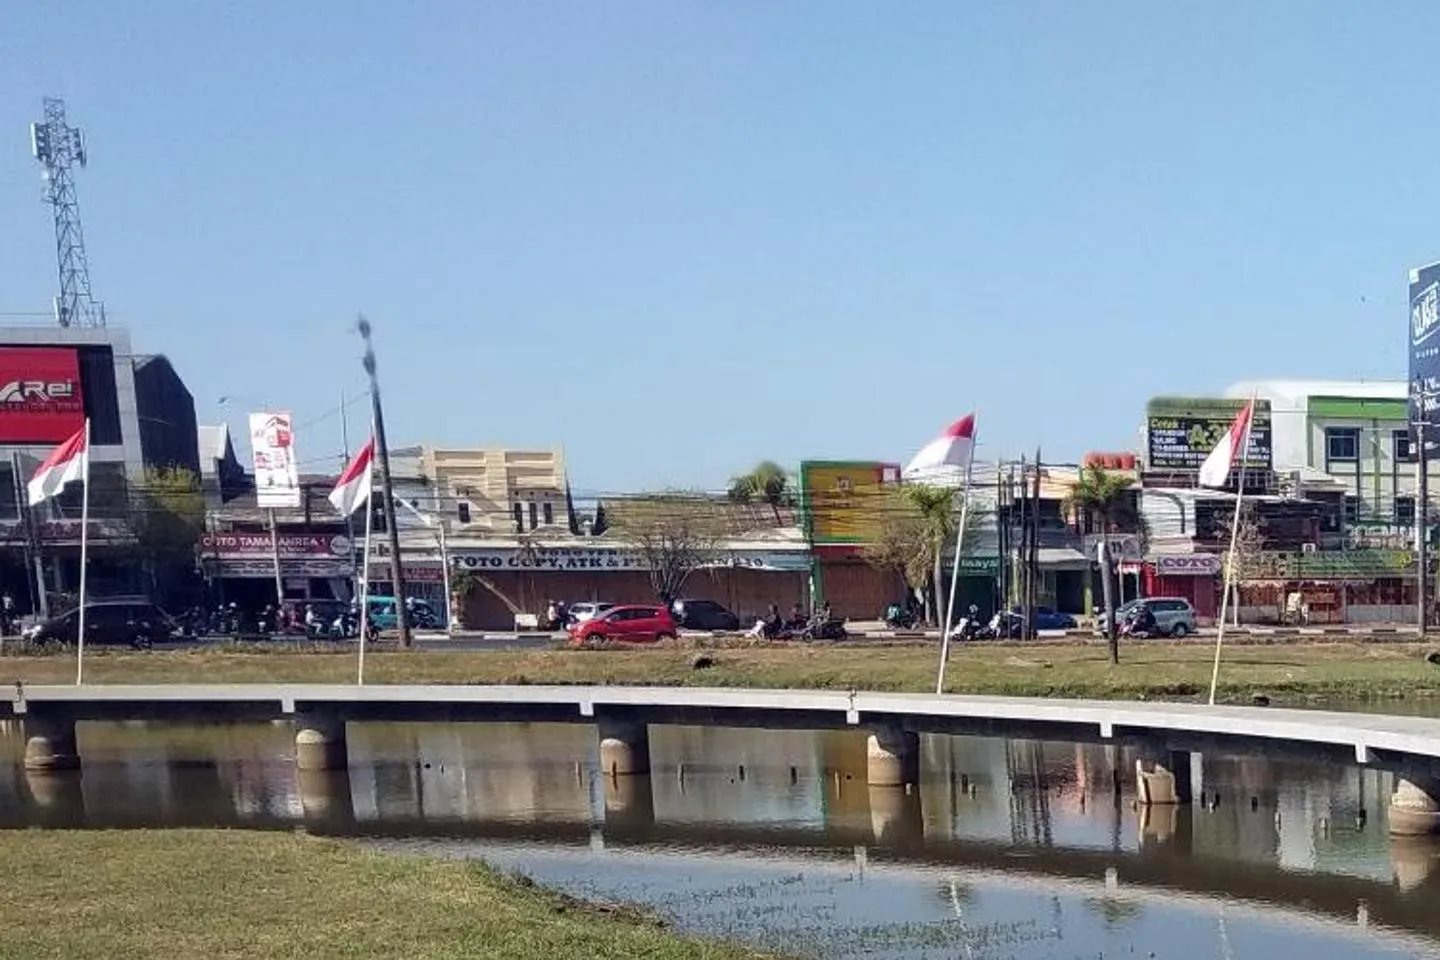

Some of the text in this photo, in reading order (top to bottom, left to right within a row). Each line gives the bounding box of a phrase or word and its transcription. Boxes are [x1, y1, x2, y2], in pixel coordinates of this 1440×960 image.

[239, 536, 319, 547] TAMAANREA
[452, 556, 503, 568] FOTO
[566, 557, 602, 568] ATK
